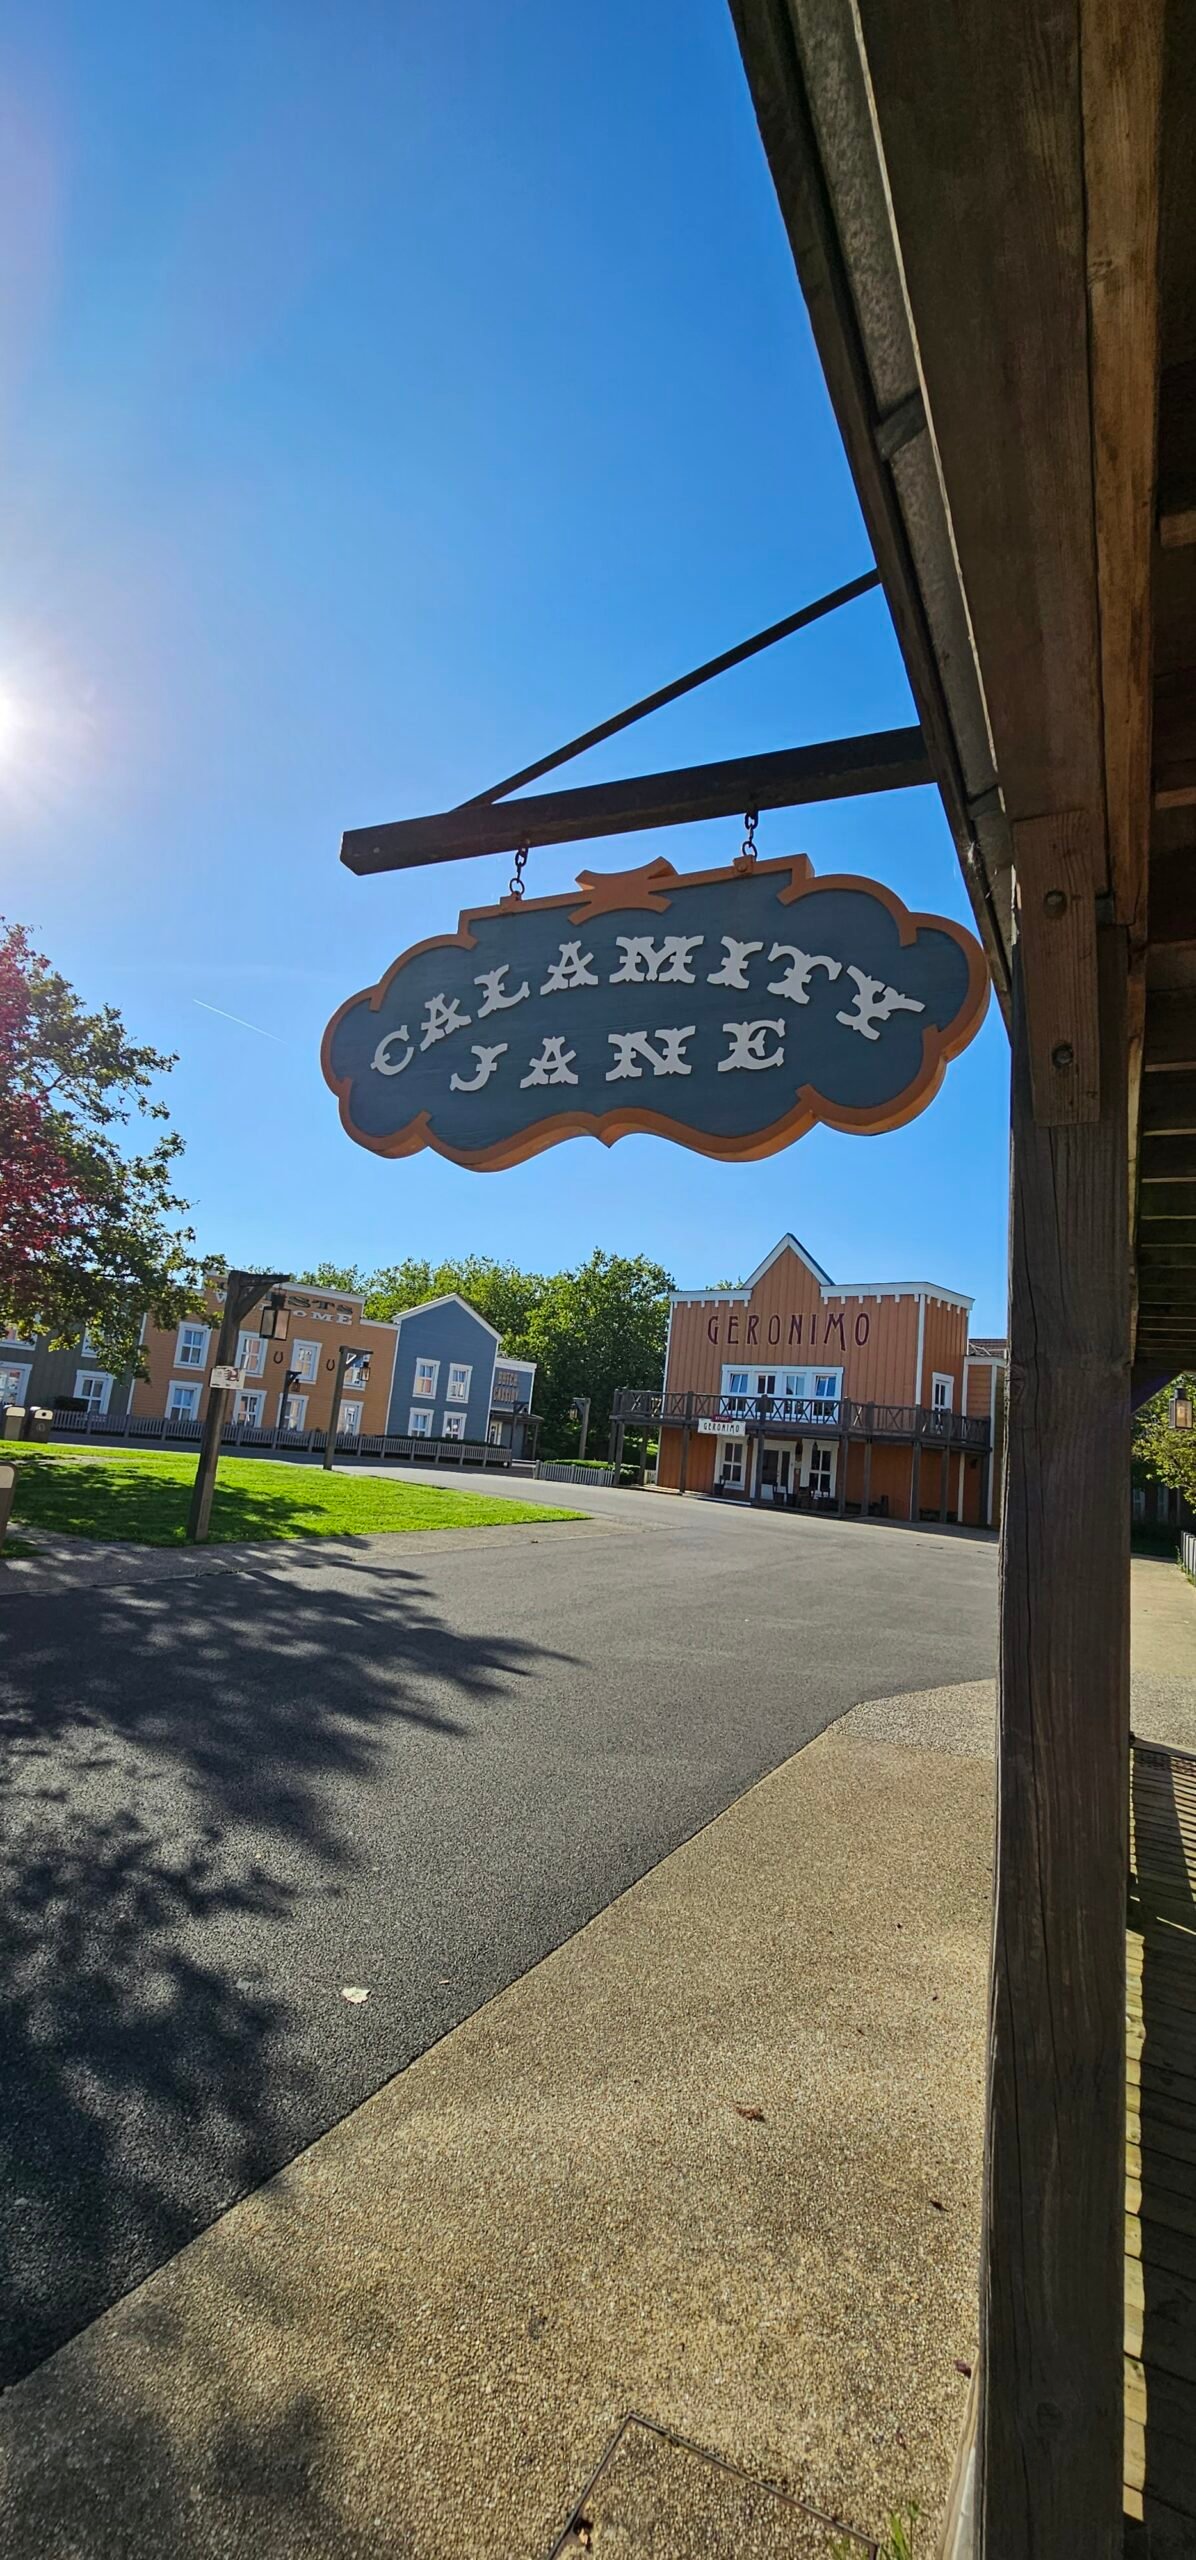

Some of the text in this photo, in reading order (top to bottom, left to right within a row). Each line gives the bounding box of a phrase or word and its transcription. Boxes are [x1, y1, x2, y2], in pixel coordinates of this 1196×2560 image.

[371, 935, 925, 1075] CALAMITY
[450, 1018, 785, 1091] JANE
[707, 1312, 870, 1351] GERONIMO
[703, 1422, 740, 1434] GERONIMO
